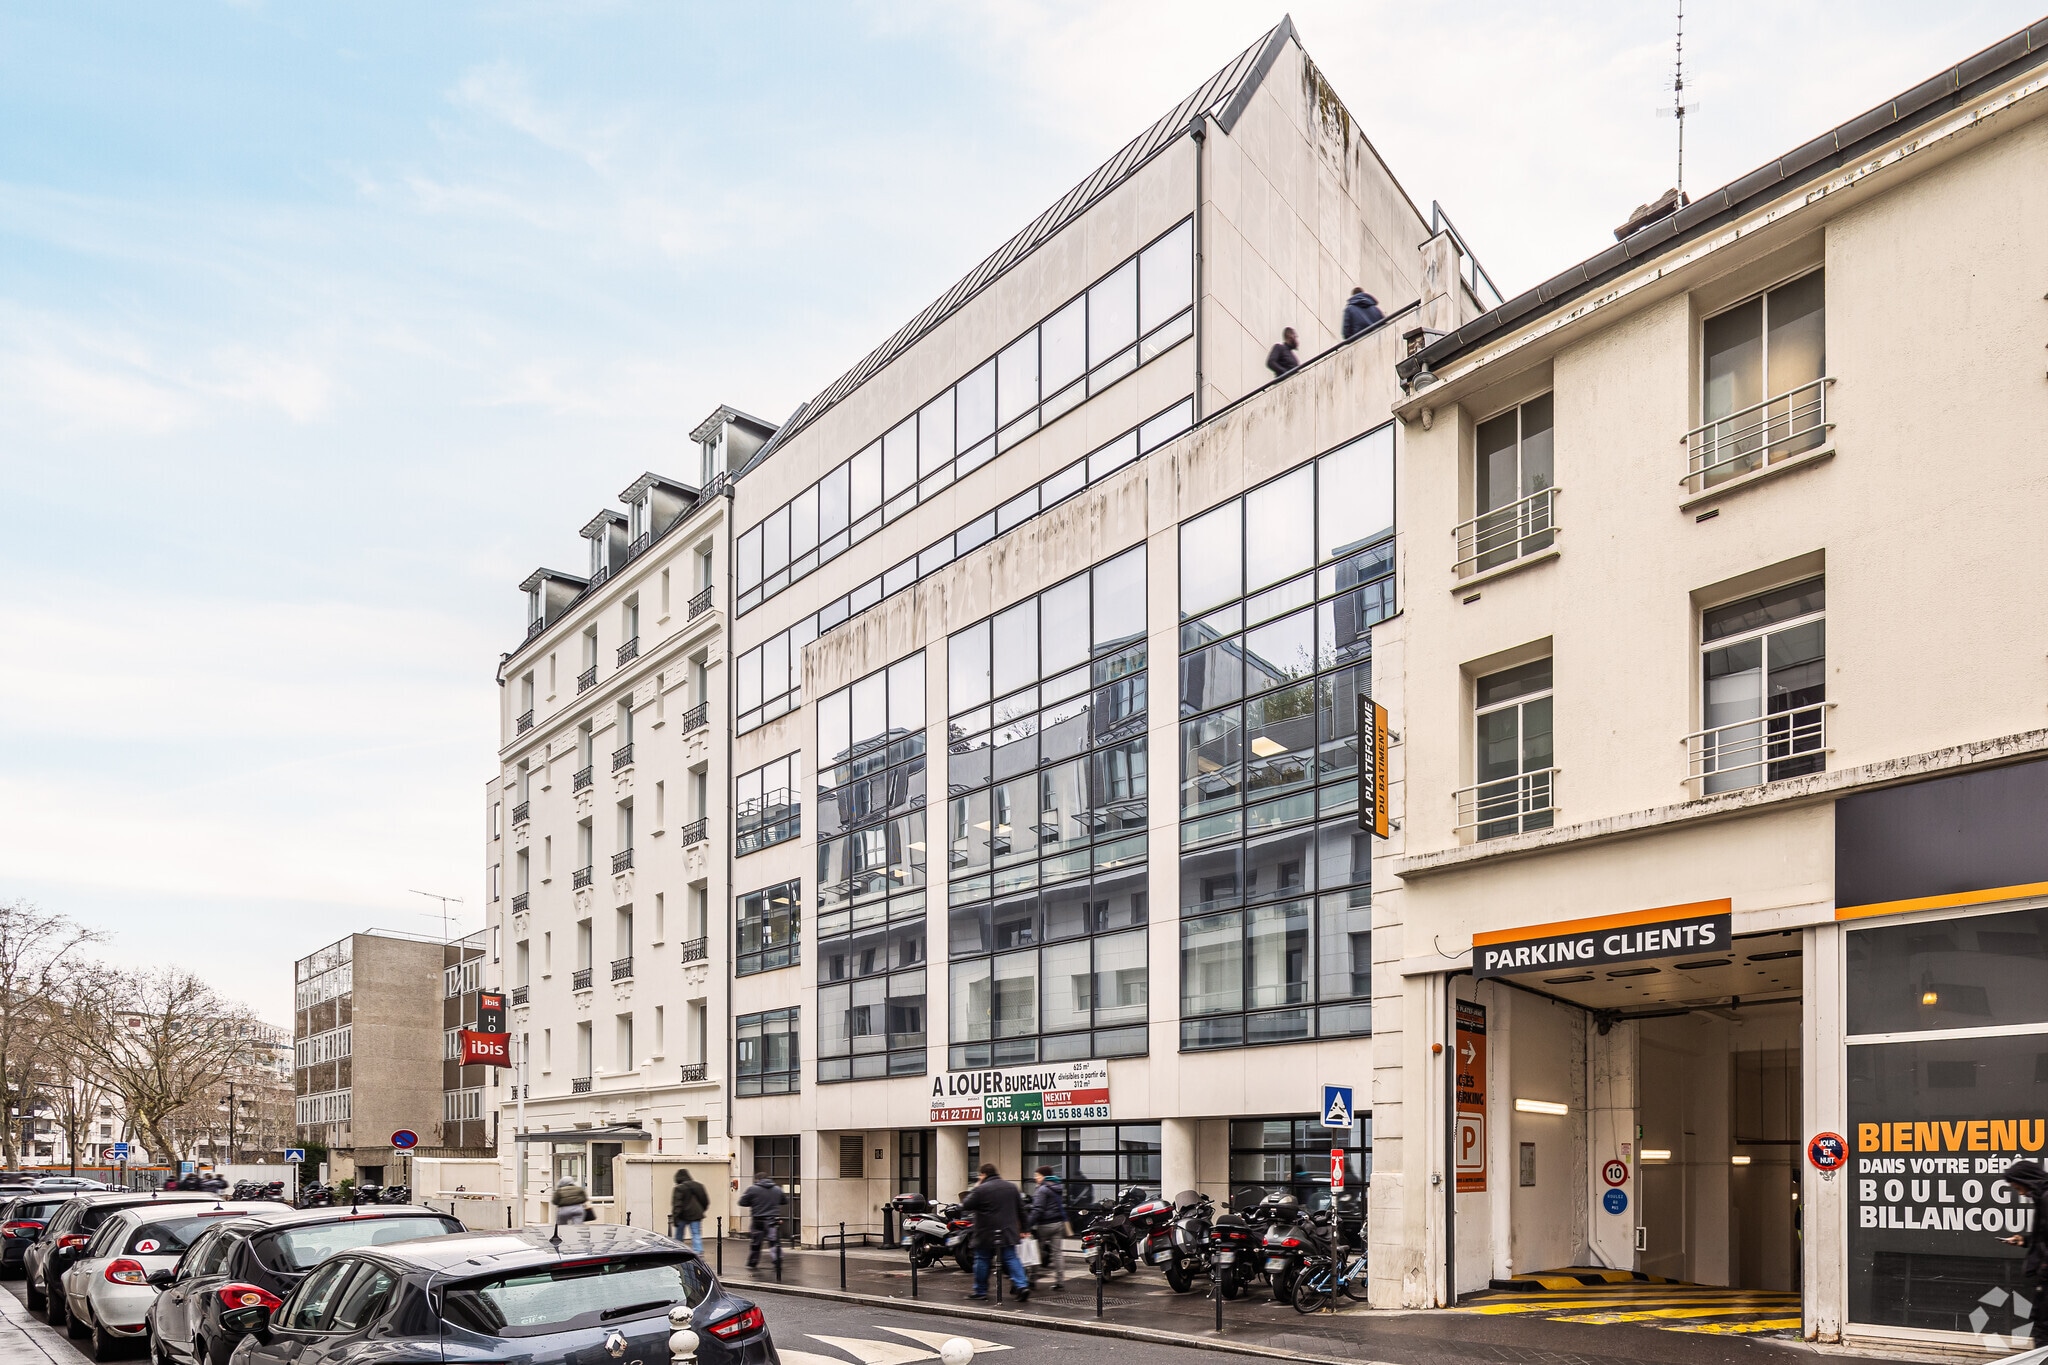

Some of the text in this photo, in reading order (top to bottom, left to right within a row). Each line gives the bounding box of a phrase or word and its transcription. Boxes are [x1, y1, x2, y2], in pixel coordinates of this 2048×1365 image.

[1364, 701, 1374, 827] LA PLATEFORME
[1379, 795, 1385, 814] DU
[1485, 923, 1716, 970] PARKING CLIENTS
[485, 999, 499, 1007] ibis
[471, 1041, 504, 1055] ibis
[1058, 1072, 1079, 1080] divisibles
[1085, 1070, 1098, 1080] partir
[1099, 1070, 1106, 1078] de
[932, 1072, 1056, 1096] A LOUER BUREAUX
[985, 1096, 1011, 1109] CBRE
[1044, 1092, 1072, 1102] NEXITY
[931, 1108, 980, 1120] 01 41 22 77 77
[986, 1110, 1042, 1122] 01 53 64 34 26
[1046, 1106, 1108, 1119] 01 56 88 48 83
[1858, 1119, 2045, 1152] BIENVENU
[1462, 1126, 1476, 1160] P
[1859, 1158, 1906, 1174] DANS
[1910, 1158, 1969, 1174] VOTRE
[1975, 1154, 2038, 1174] DÉP
[1608, 1167, 1622, 1179] 10
[140, 1241, 154, 1252] A
